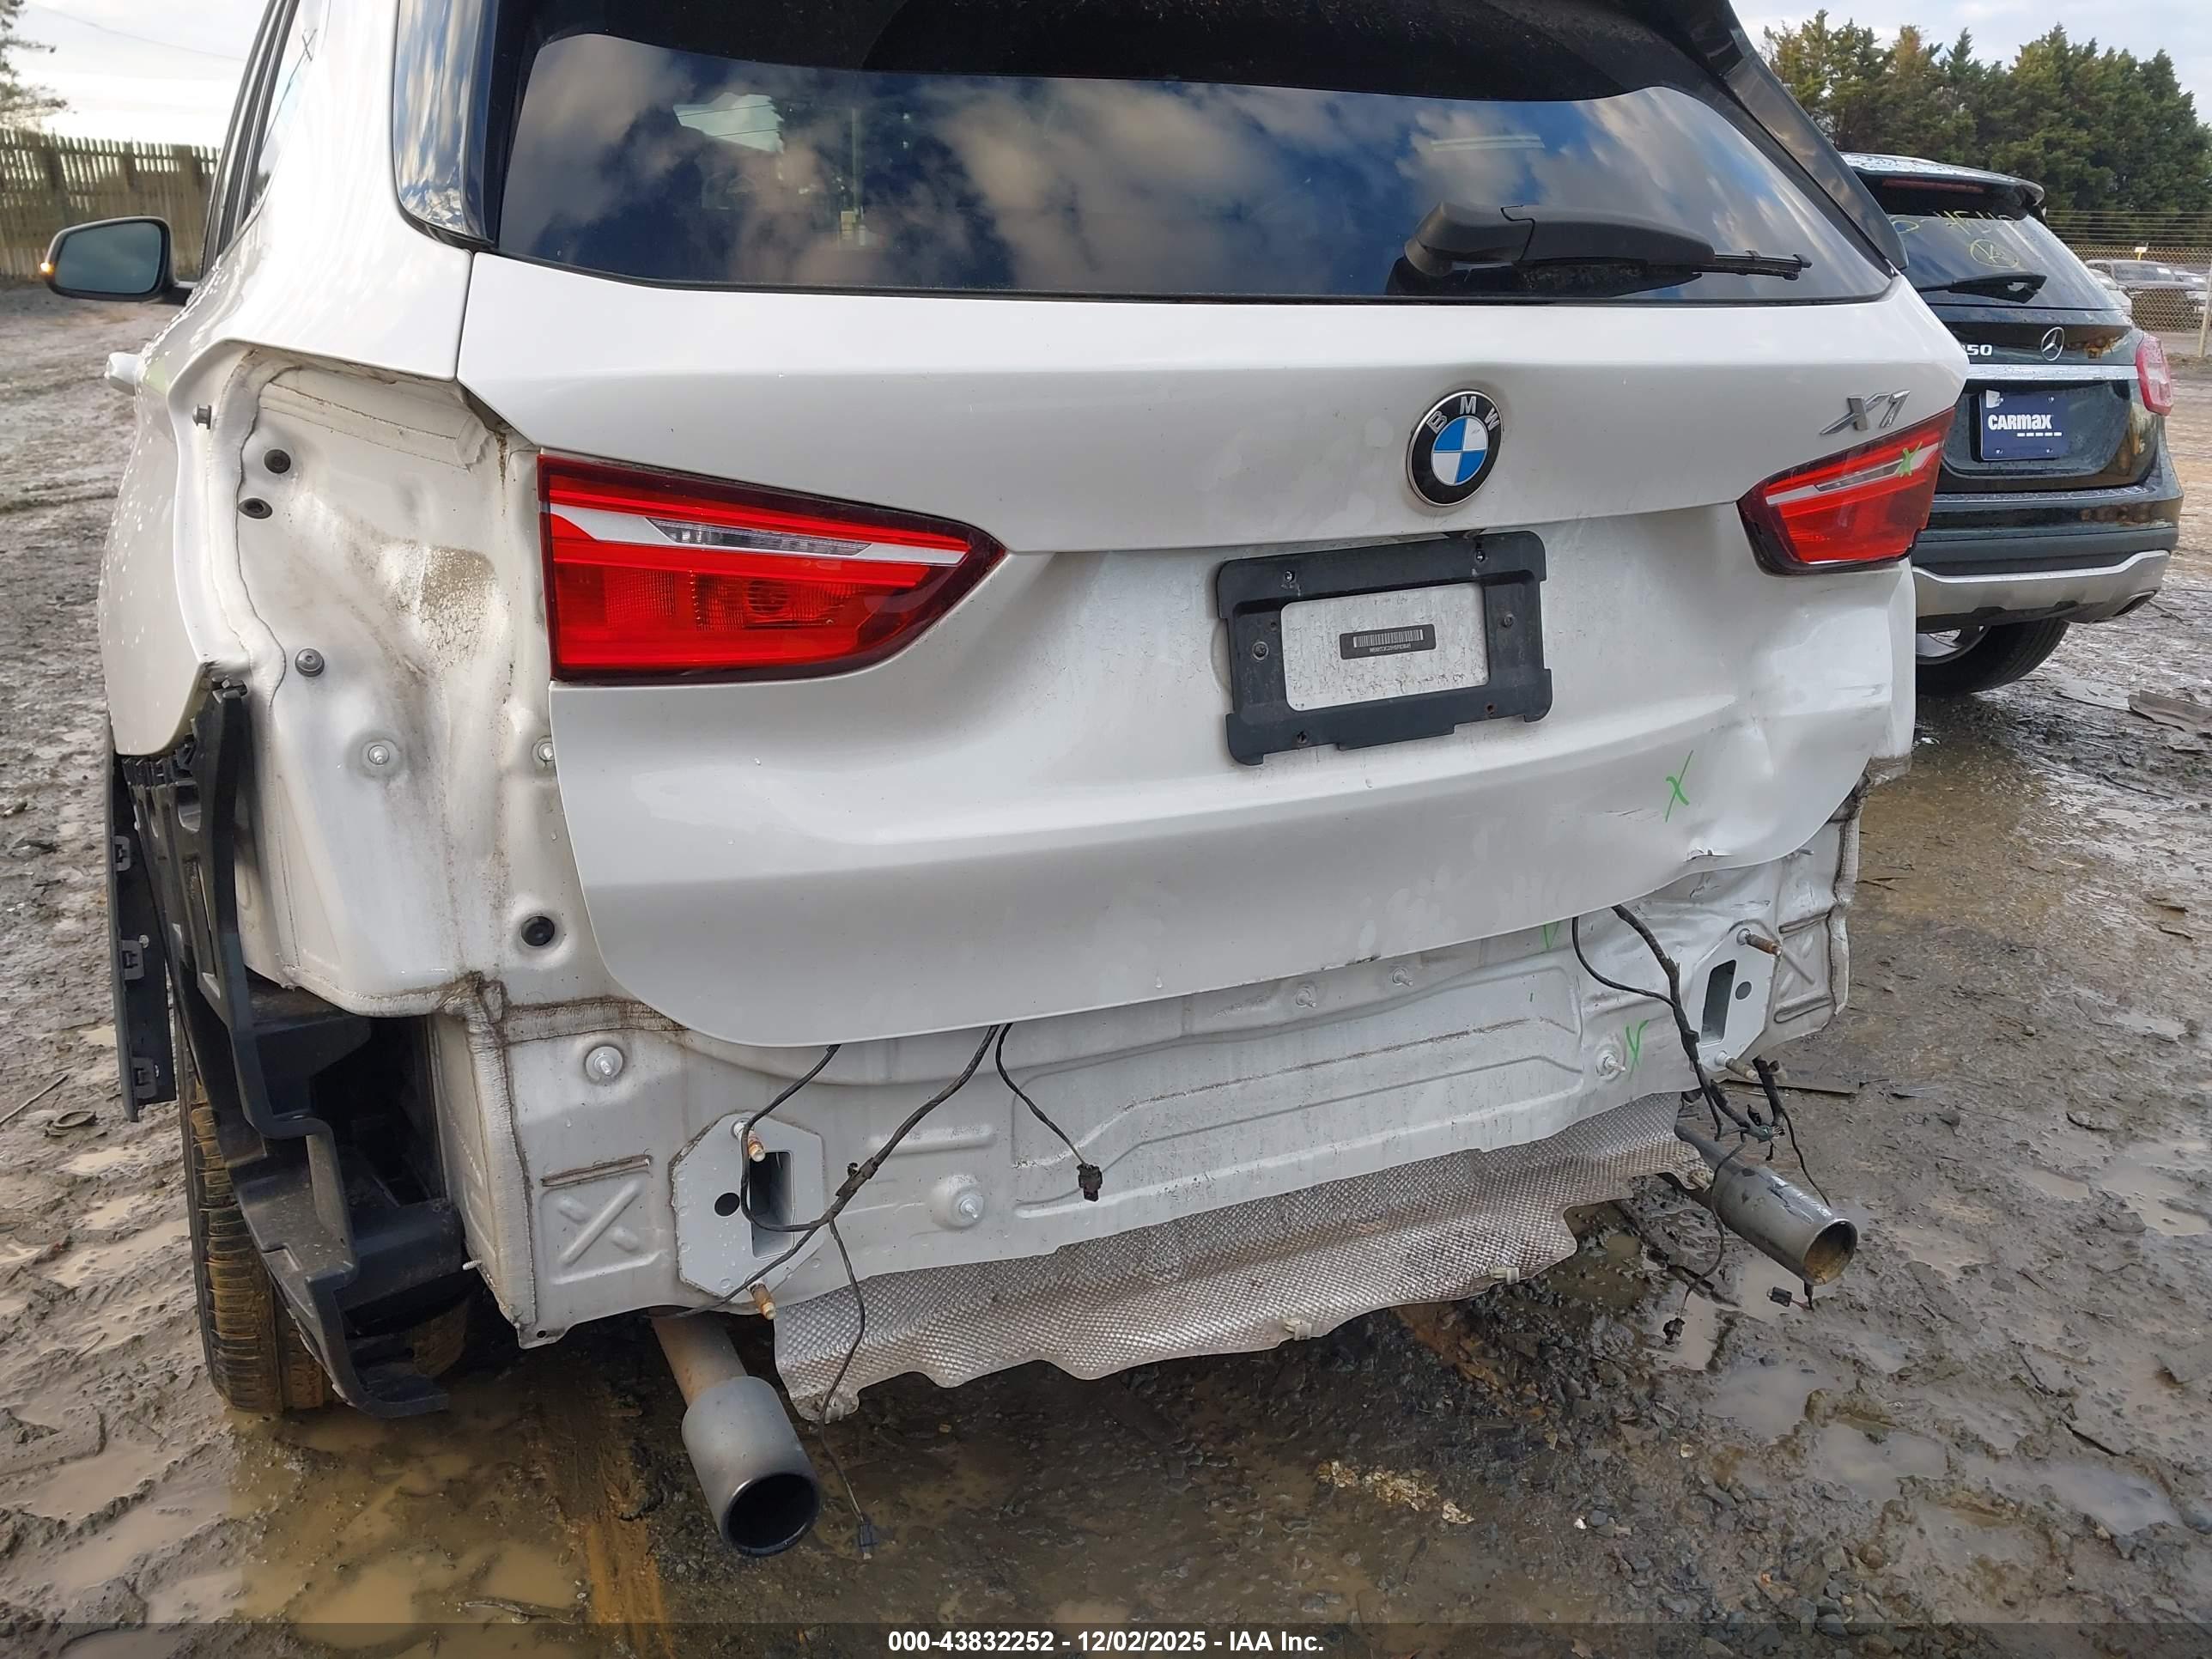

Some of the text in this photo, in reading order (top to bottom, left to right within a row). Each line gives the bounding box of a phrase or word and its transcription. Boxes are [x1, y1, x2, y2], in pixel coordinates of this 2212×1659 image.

[1961, 343, 1993, 356] 50
[1426, 396, 1500, 434] BMW
[1820, 389, 1911, 434] X1
